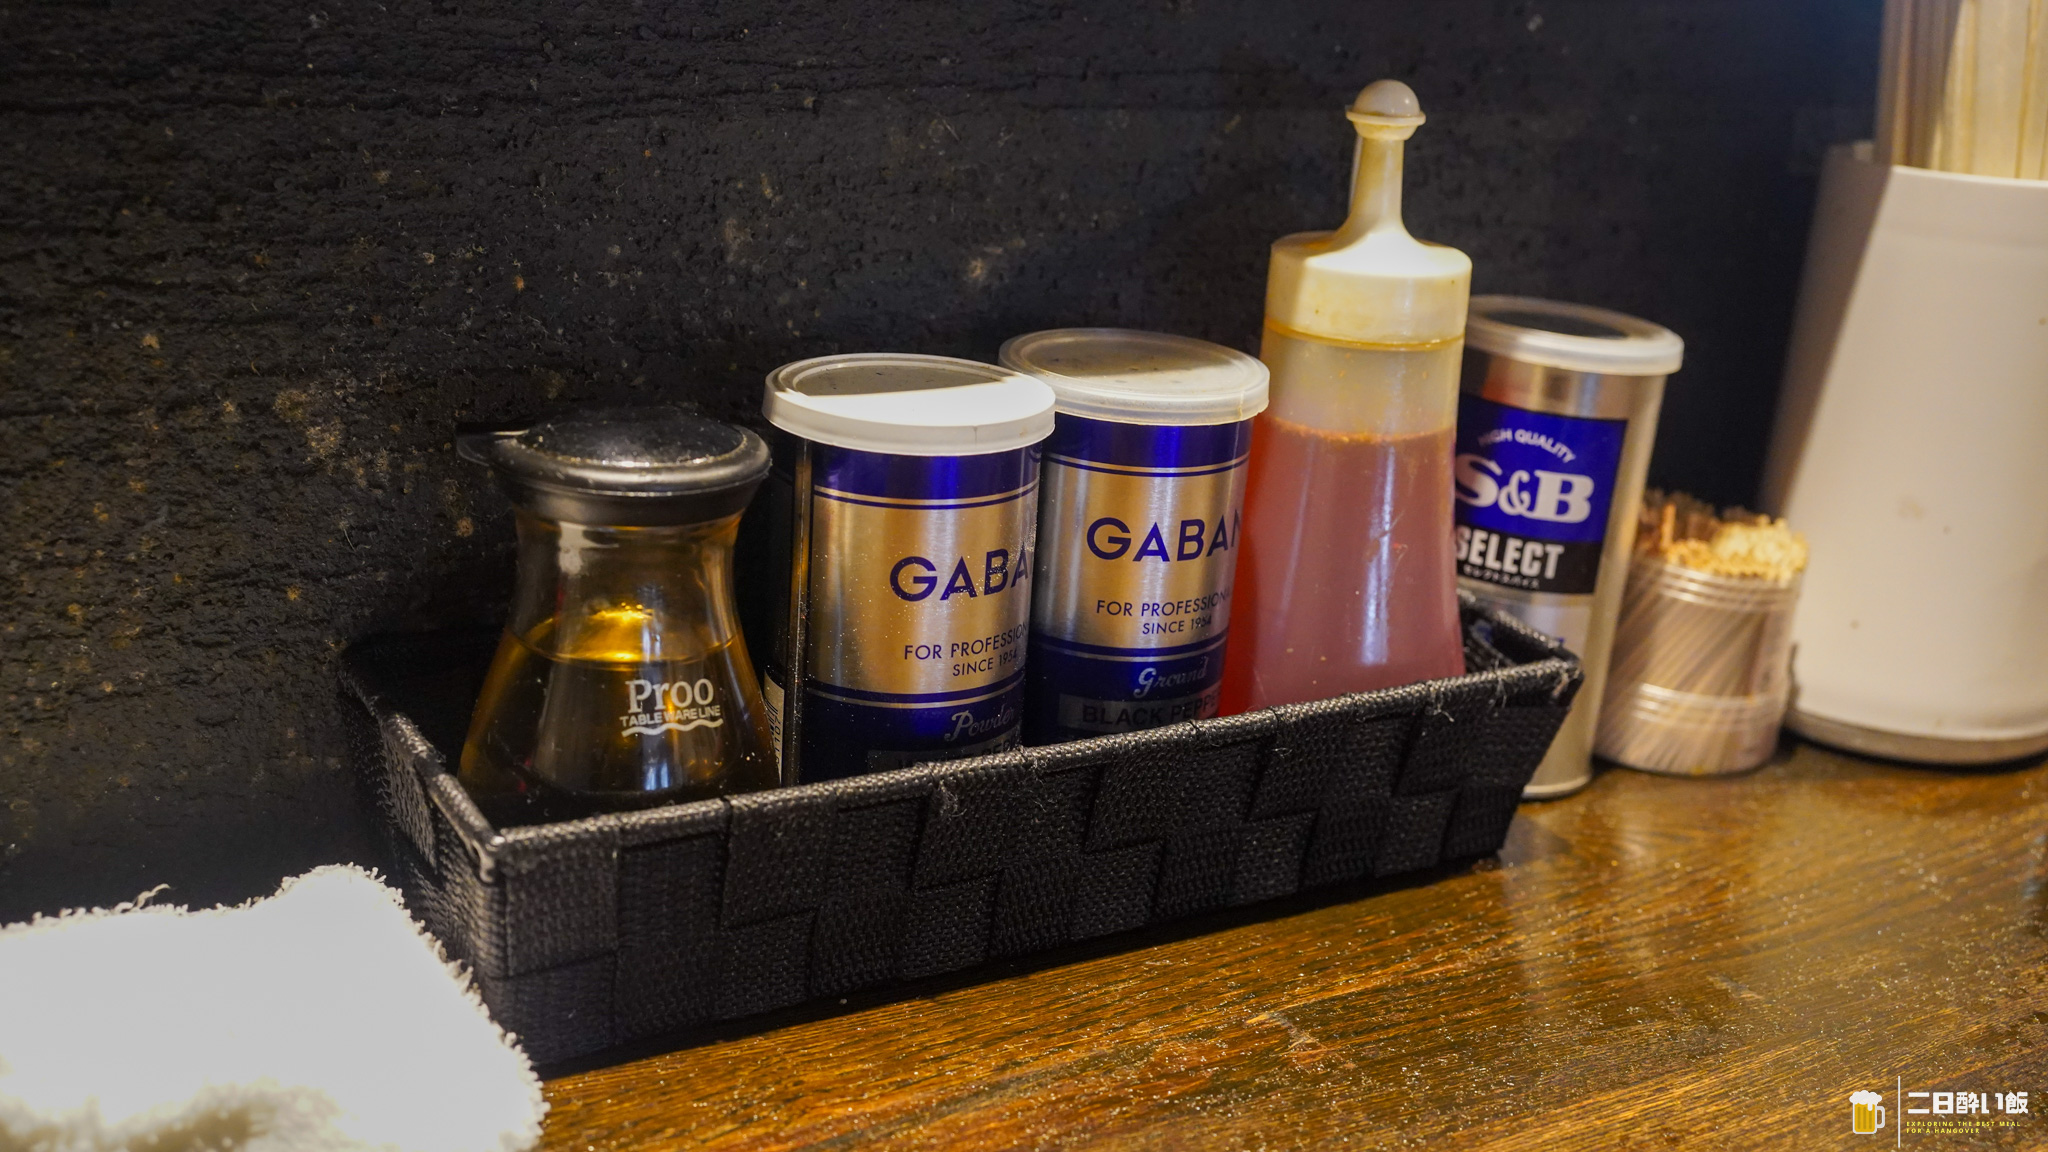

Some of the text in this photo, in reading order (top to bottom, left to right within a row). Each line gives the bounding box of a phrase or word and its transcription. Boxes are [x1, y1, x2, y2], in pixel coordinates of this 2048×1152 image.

[1477, 428, 1576, 463] HIGH QUALITY
[1455, 453, 1595, 524] S&B
[1456, 524, 1565, 580] SELECT
[1096, 600, 1133, 616] FOR
[1142, 615, 1212, 635] SINCE 1954
[904, 644, 942, 660] FOR
[953, 649, 1018, 677] SINCE 1954
[1133, 656, 1208, 698] Ground
[625, 678, 714, 714] Proo
[698, 705, 721, 718] LINE
[944, 703, 1015, 741] Powder
[1082, 704, 1163, 726] BLACK
